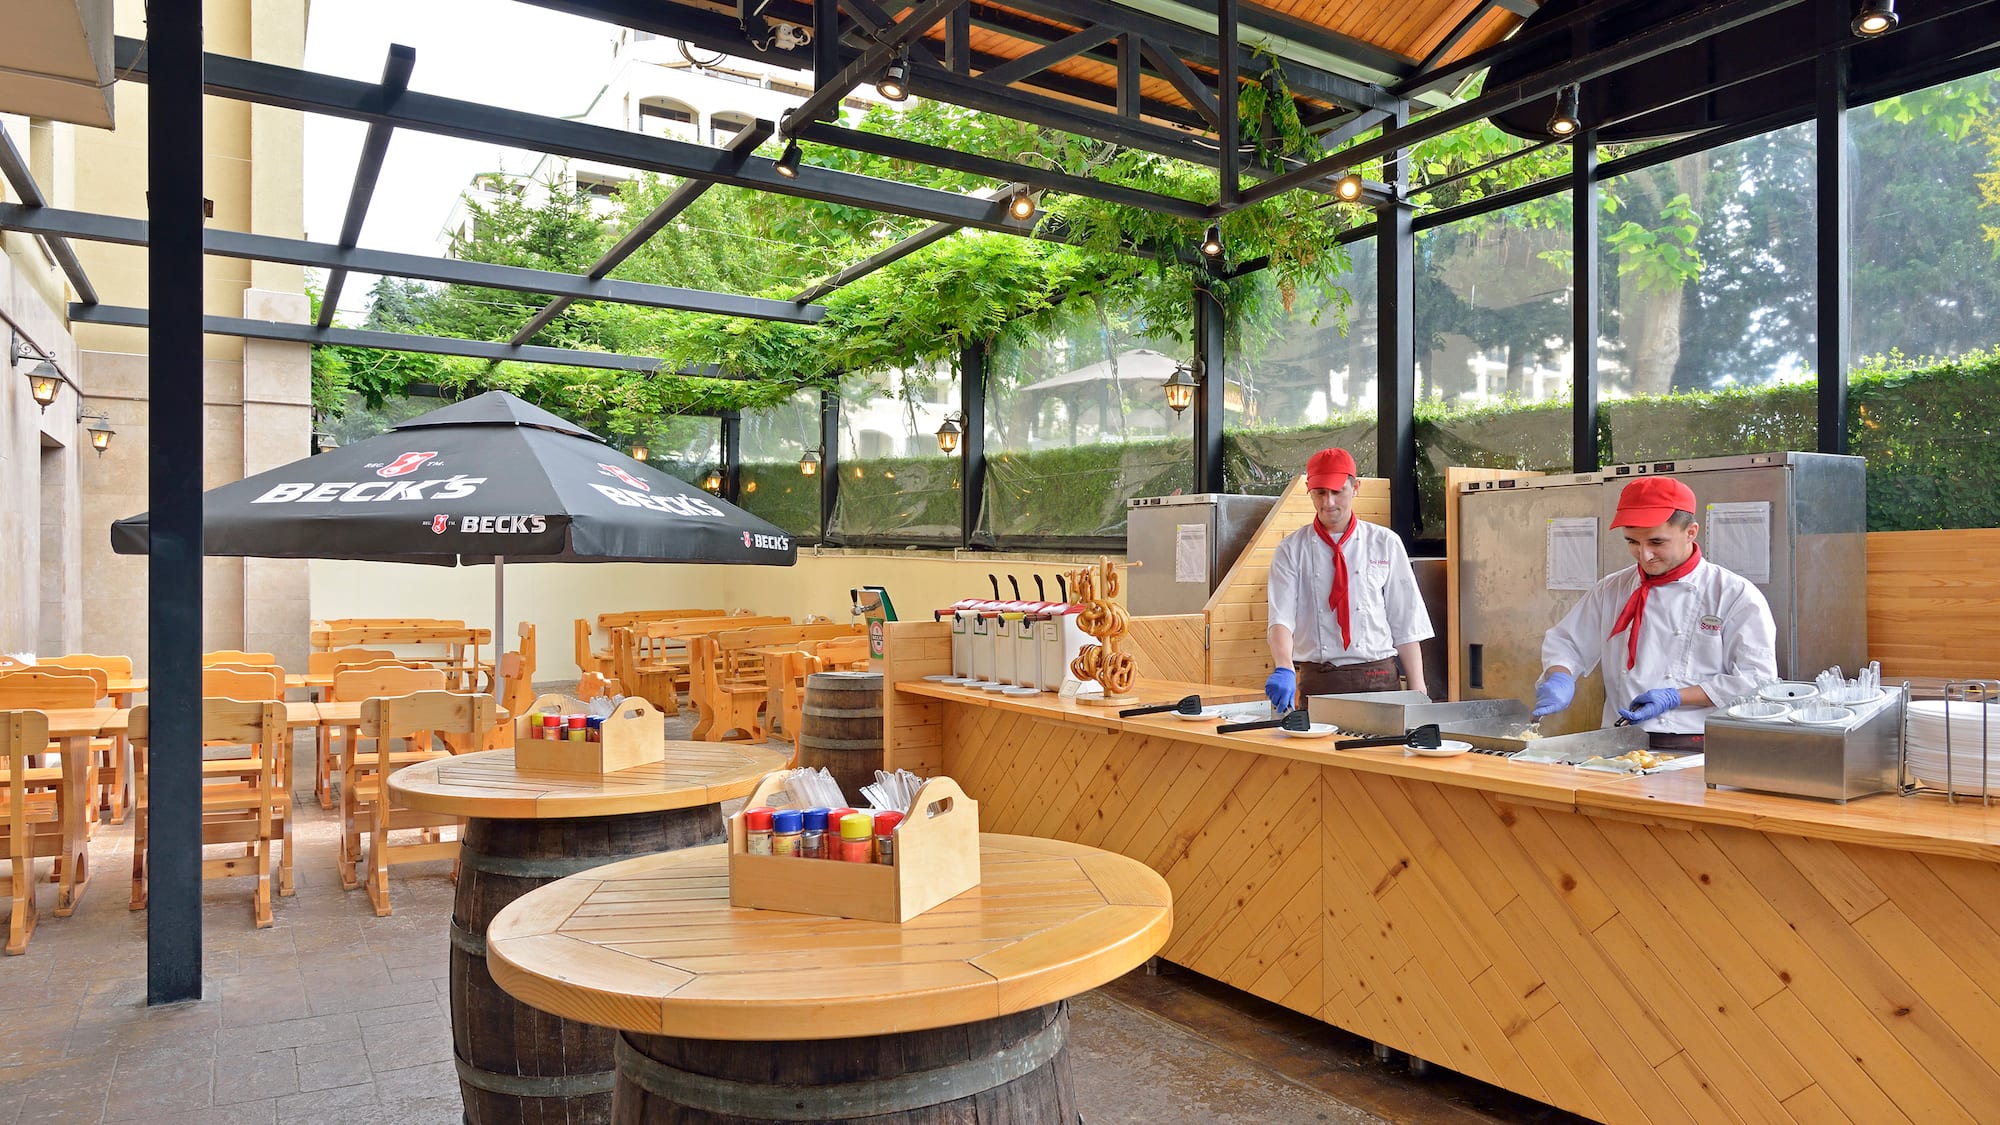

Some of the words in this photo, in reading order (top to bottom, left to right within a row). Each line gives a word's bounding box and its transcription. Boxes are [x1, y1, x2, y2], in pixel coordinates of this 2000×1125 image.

[250, 474, 488, 504] BECK'S
[587, 482, 725, 517] BECK'S
[460, 514, 547, 534] BECK'S
[753, 534, 789, 551] BECK'S
